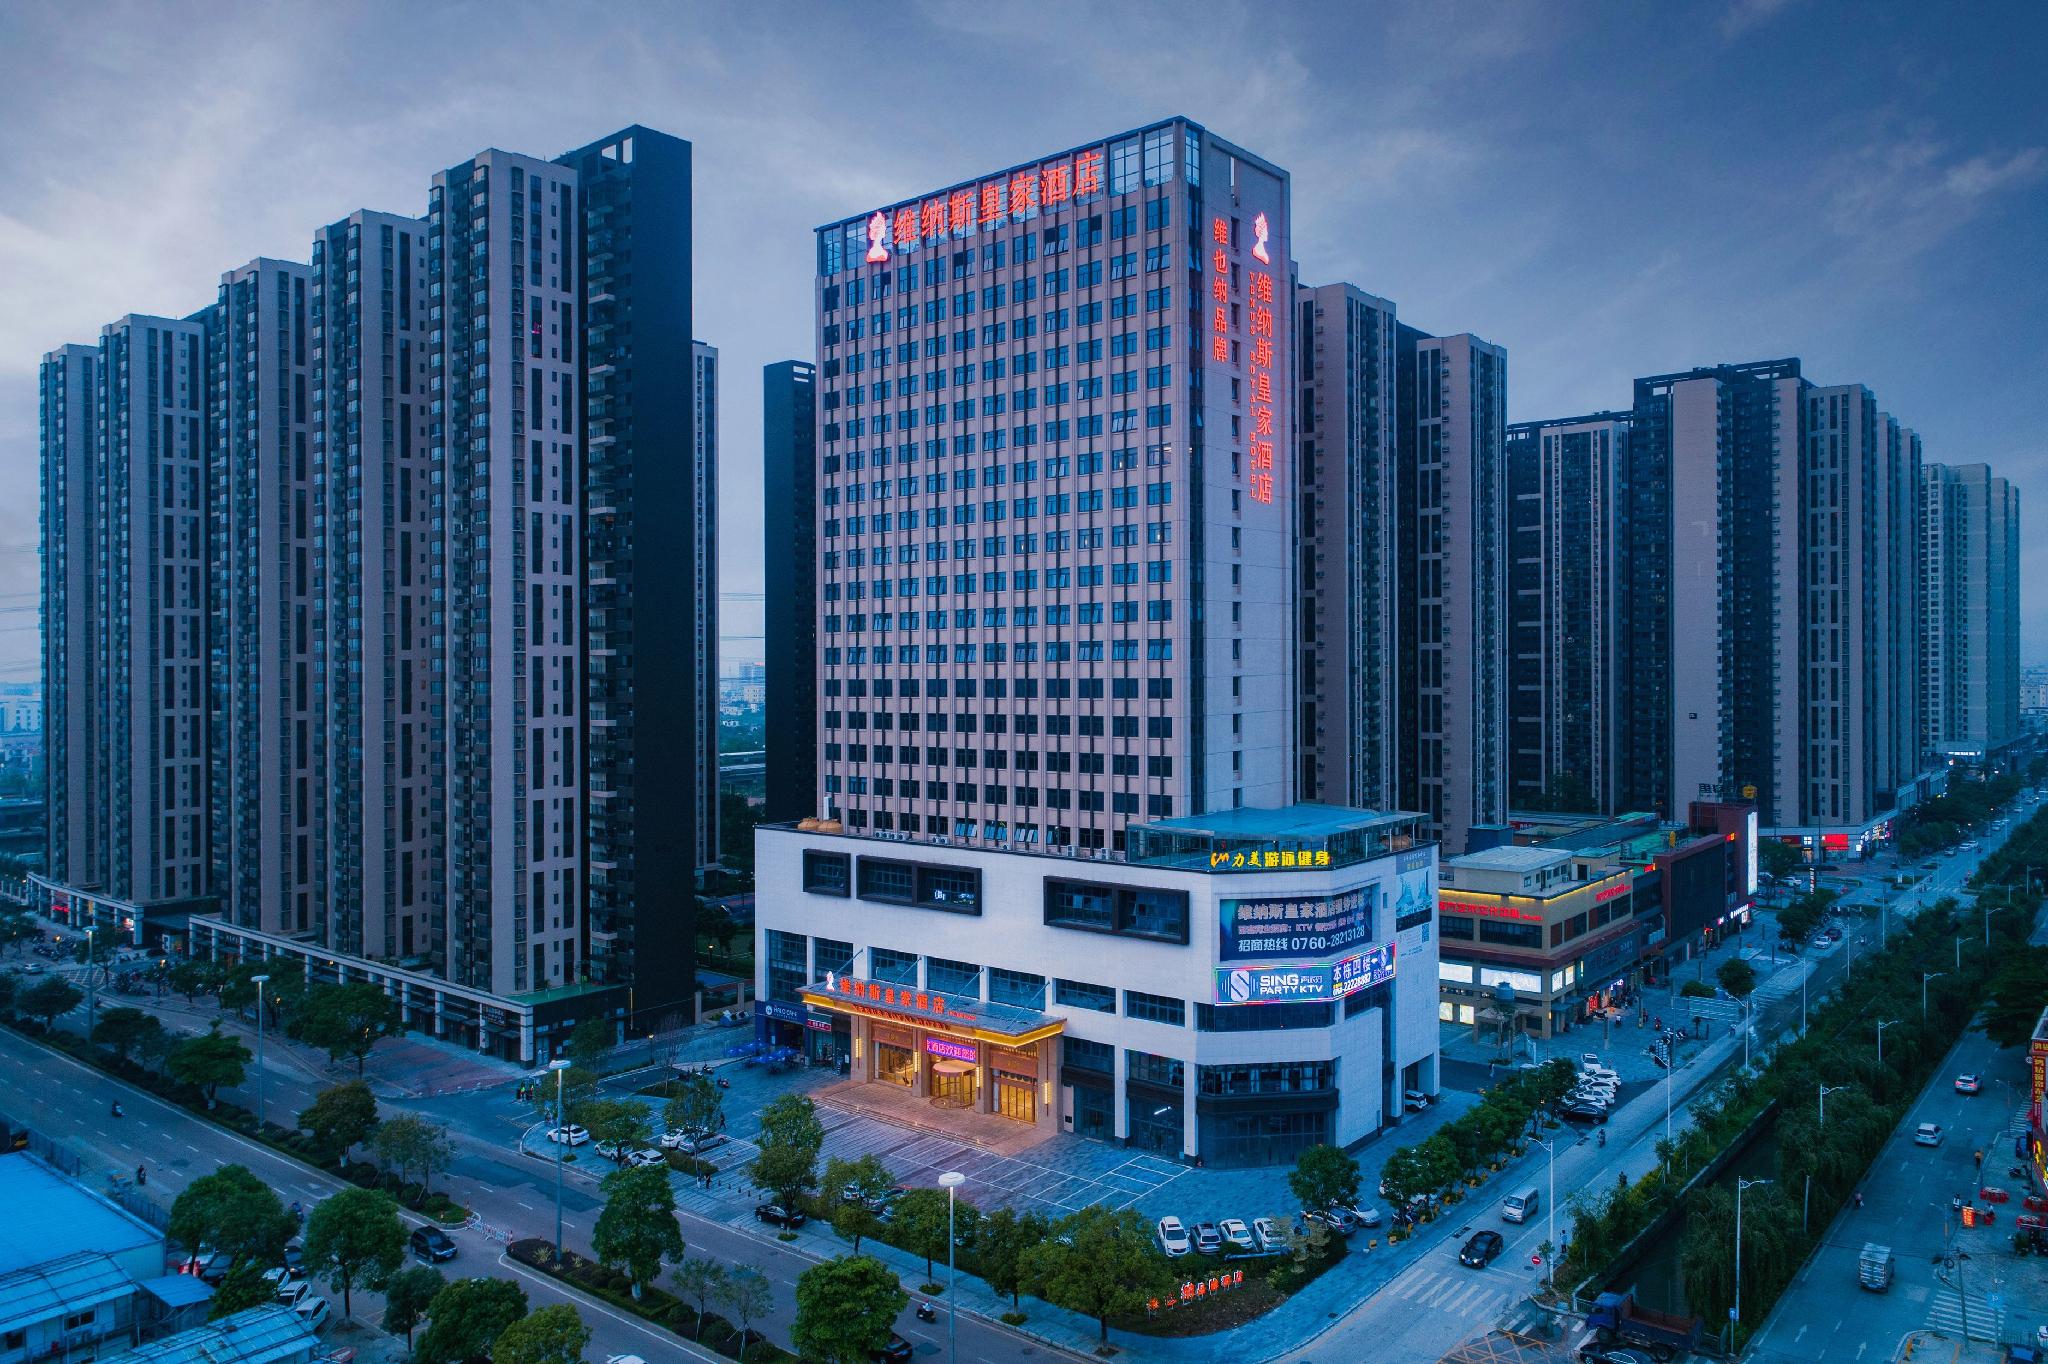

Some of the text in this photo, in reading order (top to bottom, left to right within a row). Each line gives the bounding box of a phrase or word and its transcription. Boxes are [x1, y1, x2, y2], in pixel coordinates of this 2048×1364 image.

[893, 152, 1102, 246] 维纳斯皇家酒店
[1213, 218, 1228, 362] 维也纳品牌
[1256, 272, 1273, 504] 维纳斯皇家酒店
[1238, 938, 1288, 952] 招商热线
[1291, 925, 1365, 950] 0760-28213128
[839, 977, 945, 1014] 维纳斯皇家酒店
[1260, 974, 1299, 986] SING
[1260, 986, 1297, 995] PARTY
[1300, 985, 1323, 993] KTV
